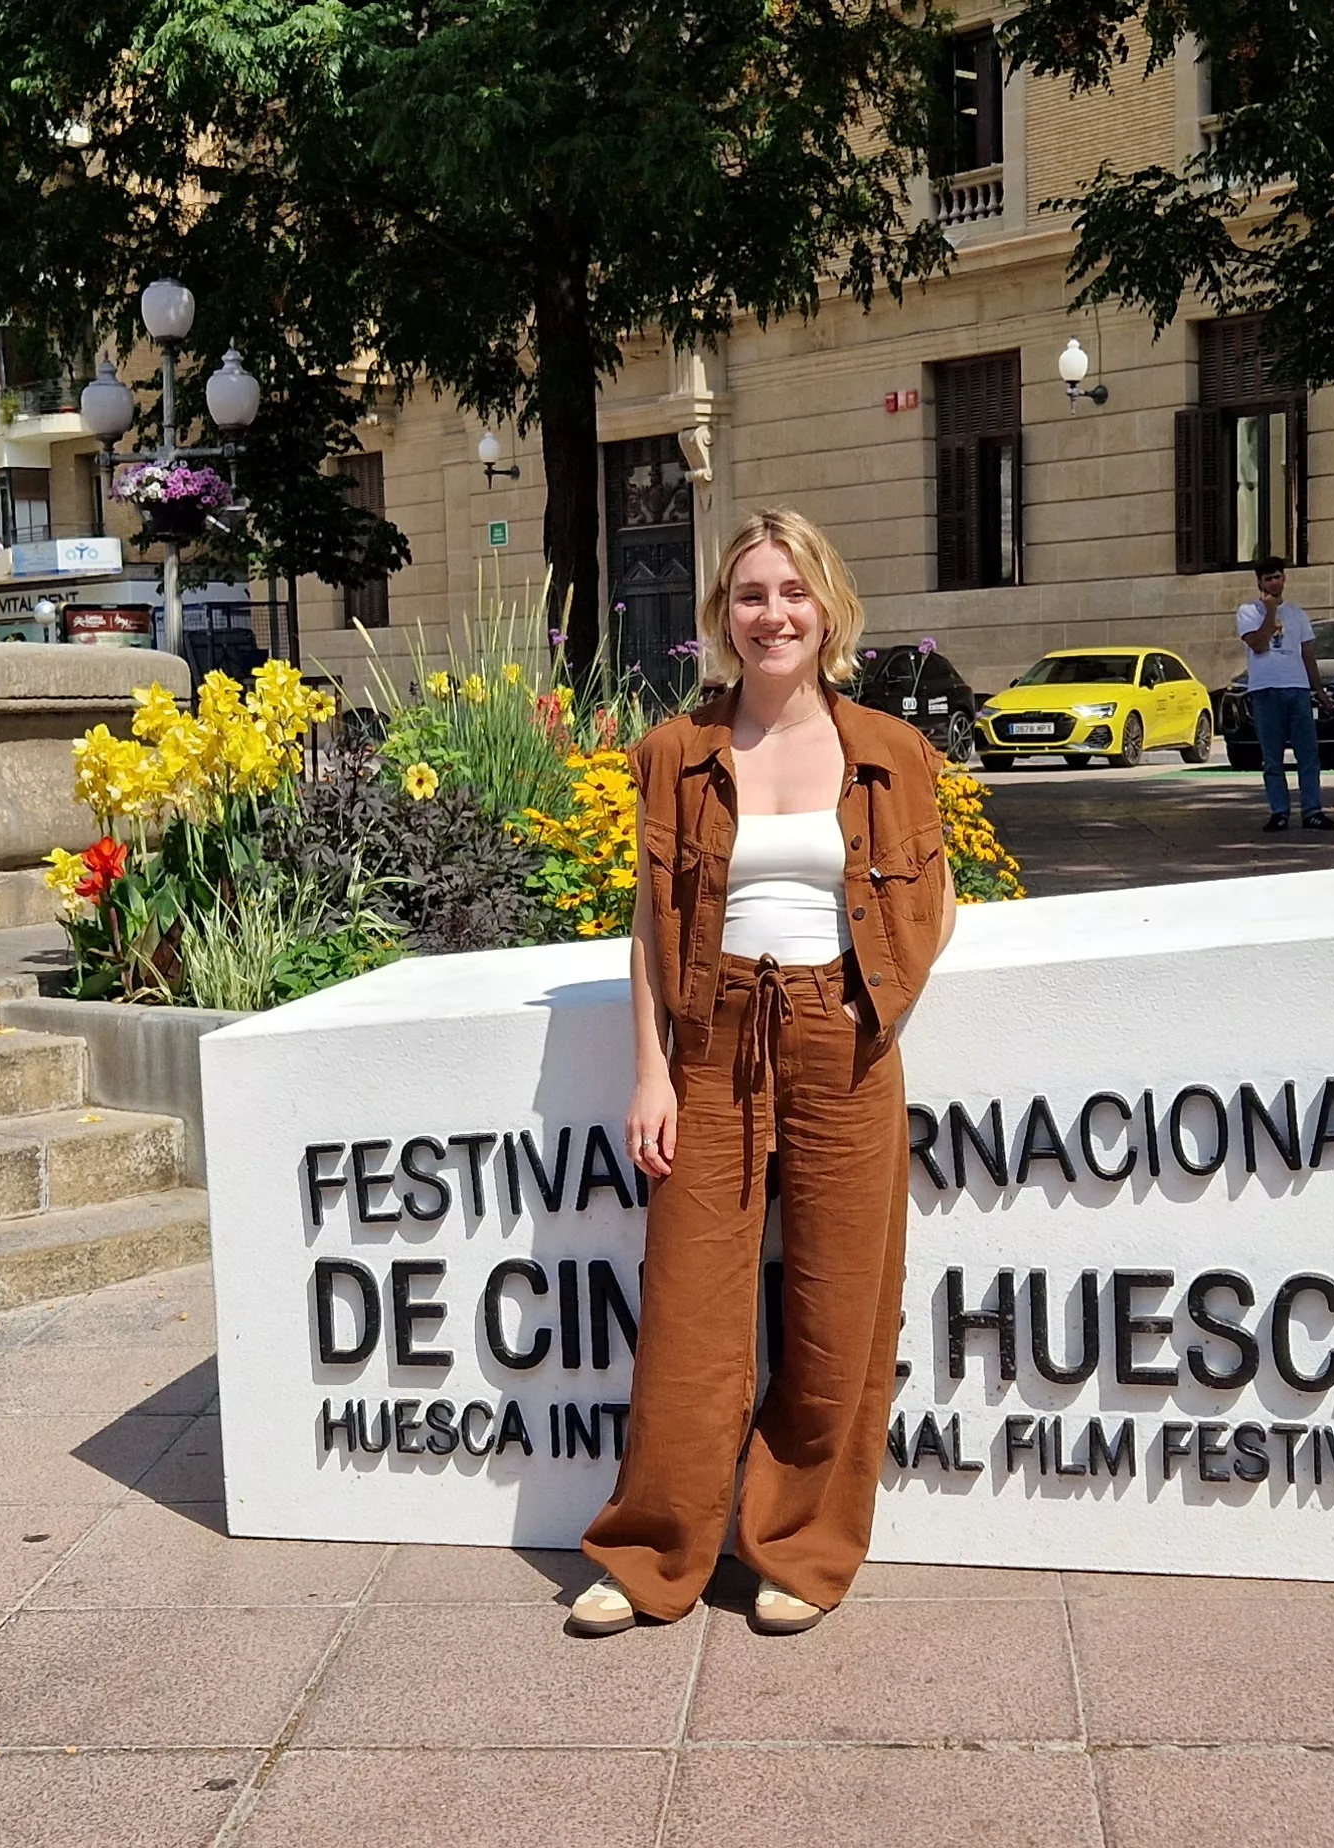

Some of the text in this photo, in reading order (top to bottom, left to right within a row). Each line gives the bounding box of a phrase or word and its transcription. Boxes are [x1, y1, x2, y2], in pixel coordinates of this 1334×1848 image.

[314, 1256, 455, 1368] DE
[483, 1256, 647, 1370] CIN
[322, 1397, 535, 1457] HUESCA
[1006, 1414, 1137, 1478] FILM
